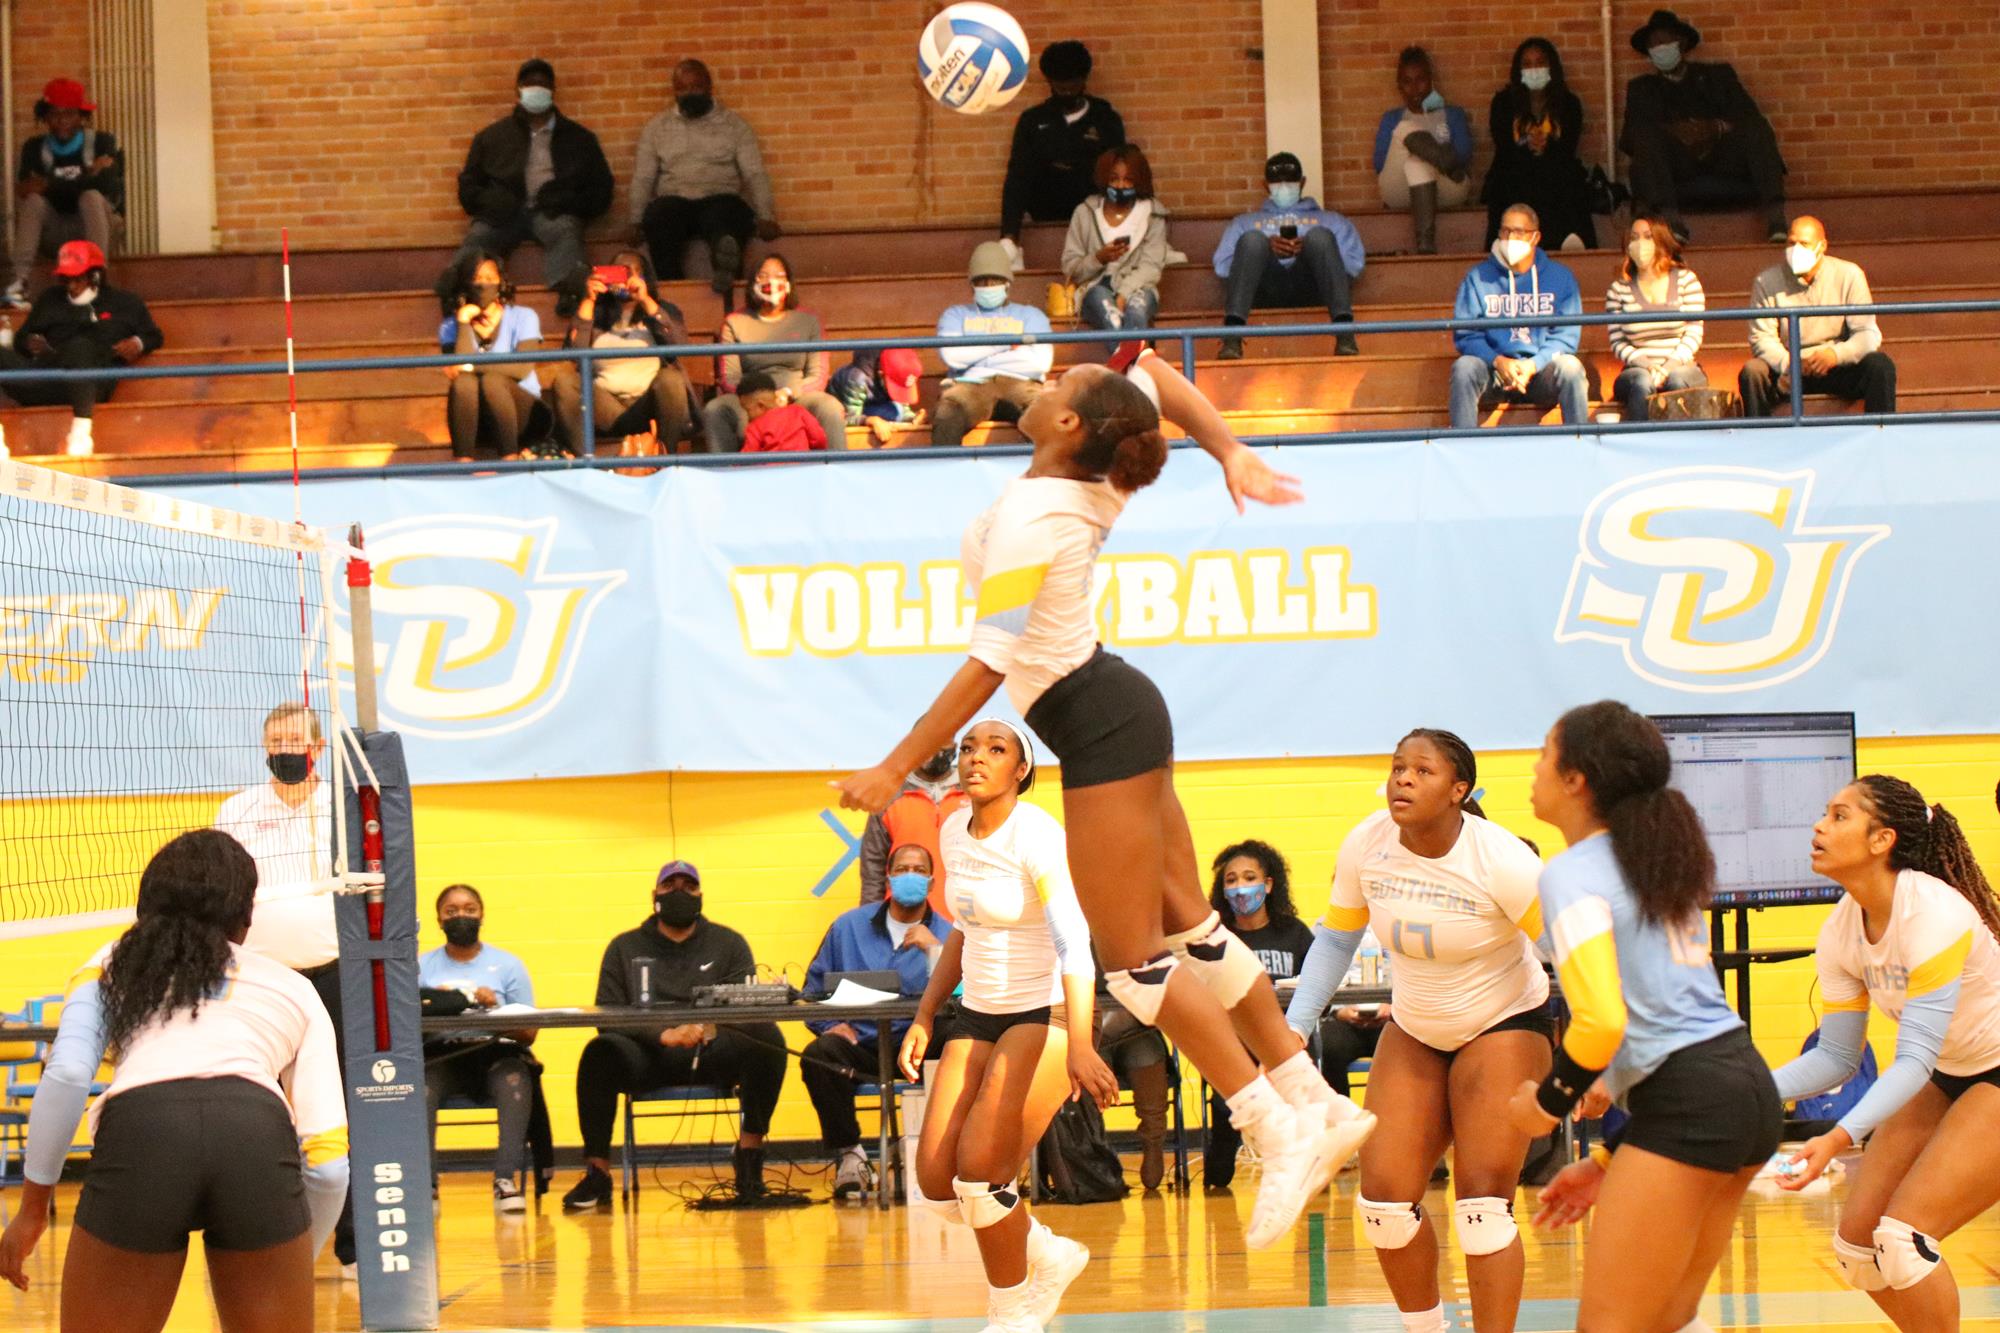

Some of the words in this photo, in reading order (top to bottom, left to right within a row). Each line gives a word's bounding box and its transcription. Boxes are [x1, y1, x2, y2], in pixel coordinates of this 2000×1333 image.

[1484, 292, 1555, 317] DUKE
[728, 546, 1378, 659] VOLLBALL
[1368, 876, 1477, 916] SOUTHERN
[1392, 918, 1436, 960] 17
